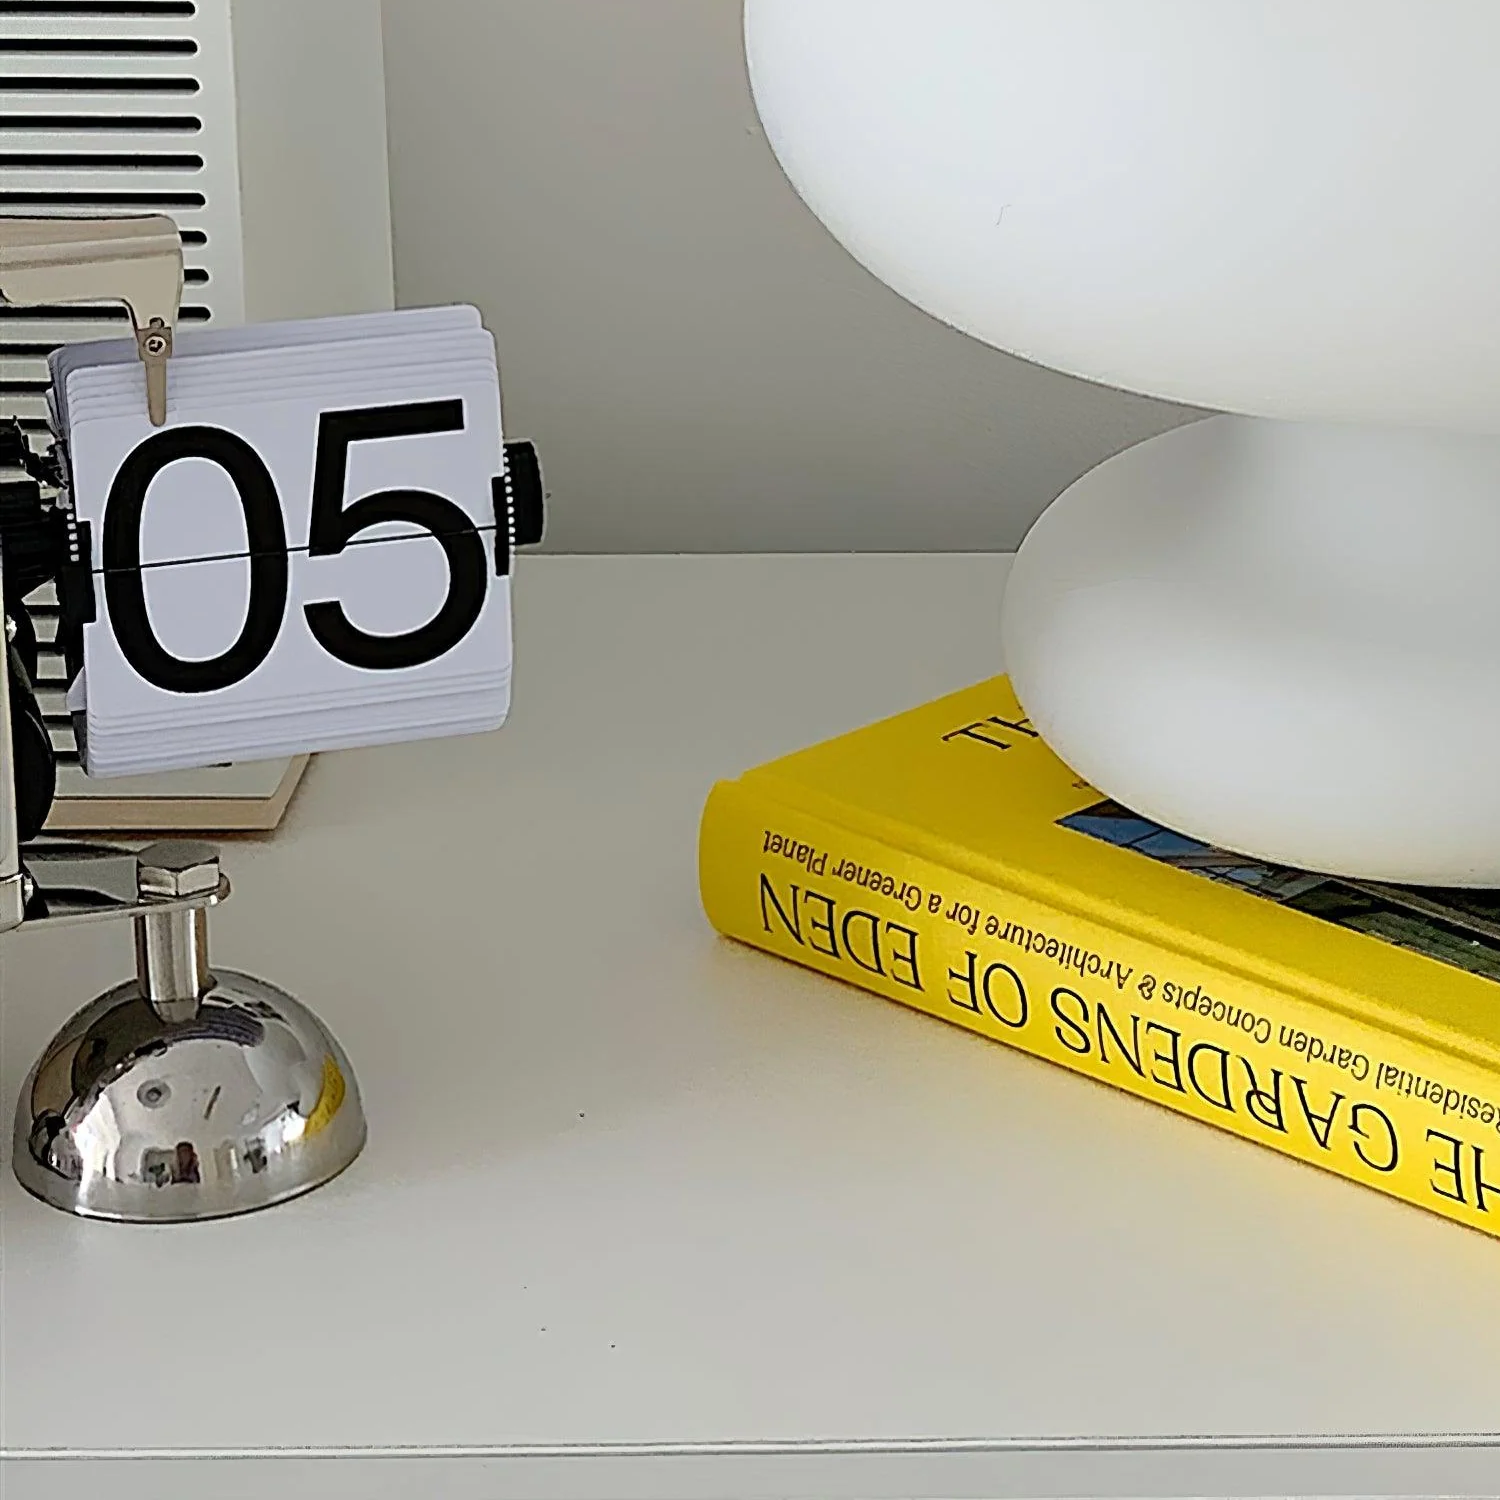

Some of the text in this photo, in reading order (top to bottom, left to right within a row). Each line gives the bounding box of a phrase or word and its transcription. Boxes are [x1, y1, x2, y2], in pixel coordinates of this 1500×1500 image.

[102, 398, 488, 694] 05
[762, 830, 829, 877] Planet
[831, 860, 922, 912] Greener
[927, 894, 941, 914] a
[759, 872, 924, 992] EDEN
[946, 902, 979, 937] for
[985, 913, 1134, 990] Architecture
[948, 951, 1029, 1029] OF
[1138, 974, 1158, 1001] &
[1162, 984, 1272, 1044] Concepts
[1048, 987, 1400, 1172] GARDENS
[1280, 1024, 1371, 1082] Garden
